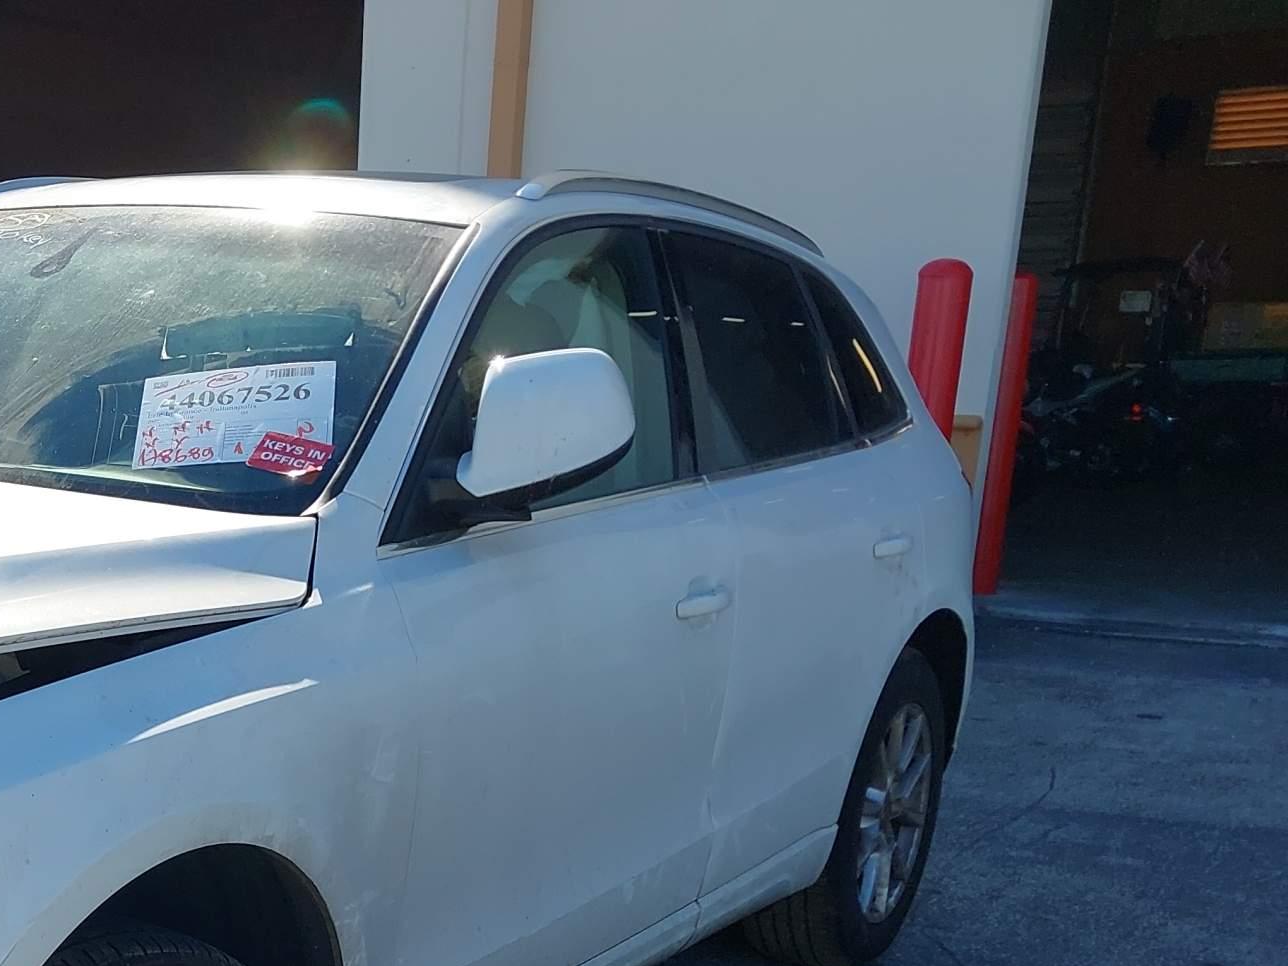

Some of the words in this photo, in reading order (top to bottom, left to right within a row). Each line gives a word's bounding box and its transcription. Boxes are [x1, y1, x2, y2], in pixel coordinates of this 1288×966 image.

[160, 382, 311, 411] 44067526
[263, 439, 305, 455] KEYS
[307, 448, 327, 461] IN
